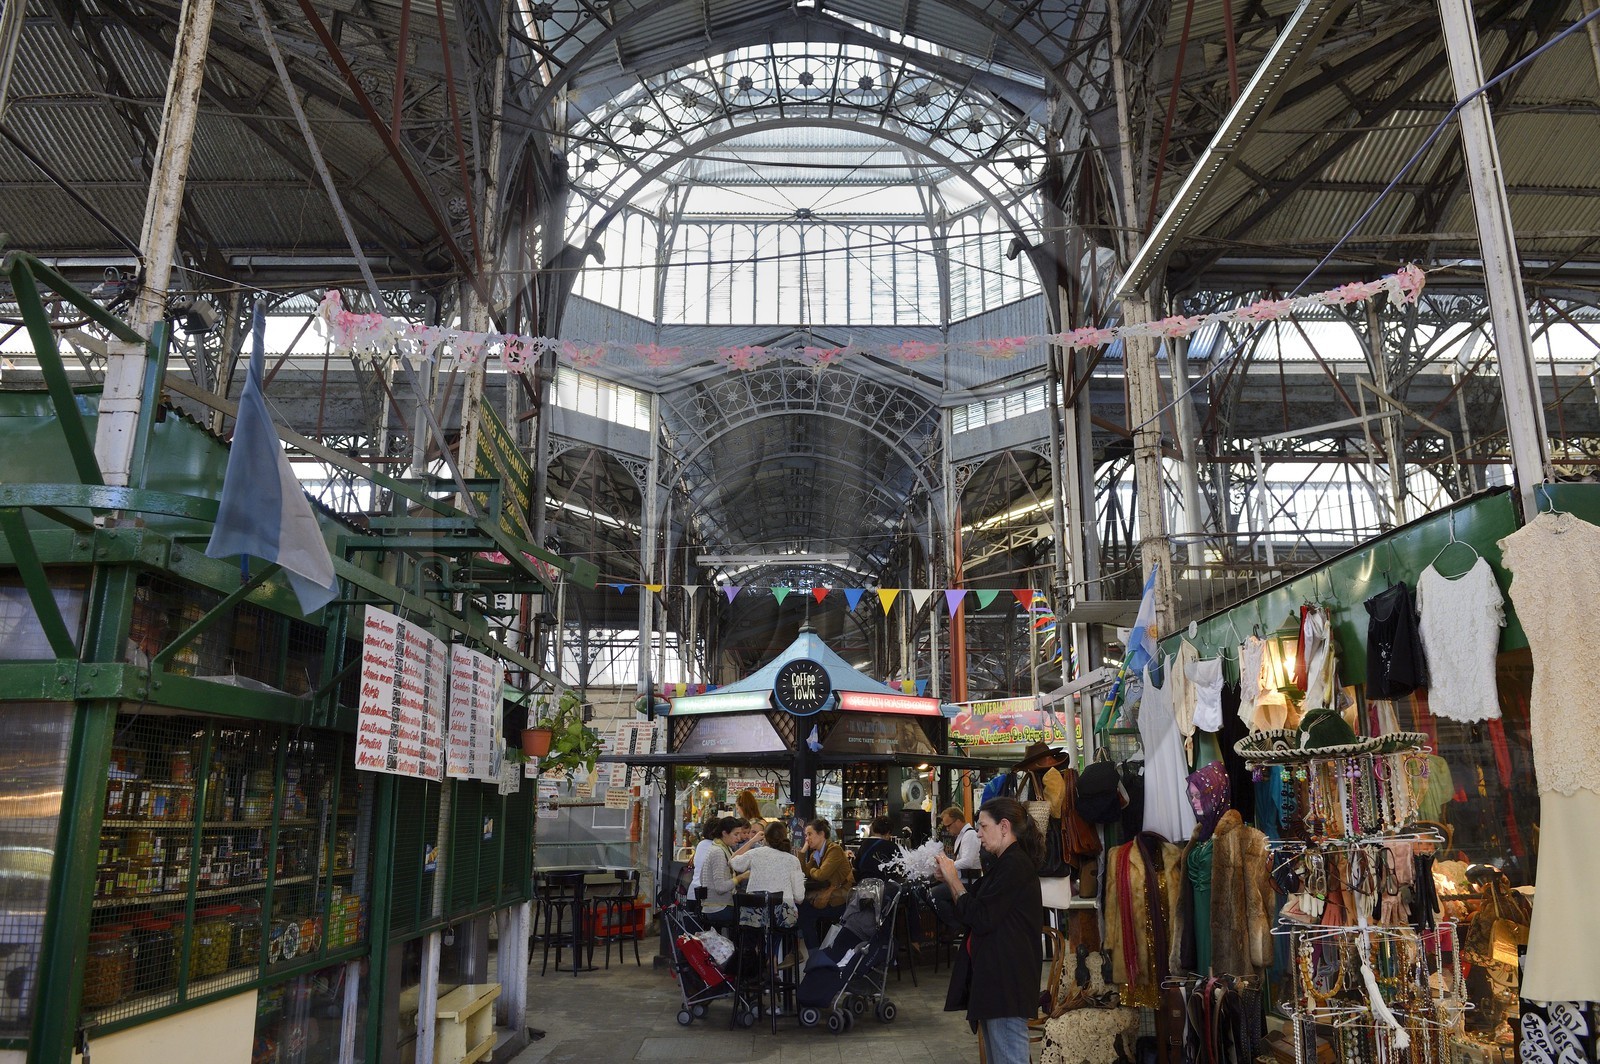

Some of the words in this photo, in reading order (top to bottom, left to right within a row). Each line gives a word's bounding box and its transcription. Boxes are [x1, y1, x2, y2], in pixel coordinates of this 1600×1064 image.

[497, 433, 529, 487] ARTESANALES
[850, 696, 884, 708] SPECIALTY
[884, 698, 910, 710] ROASTED
[910, 700, 933, 711] COFFEE
[973, 701, 1003, 716] FRUTERIA
[980, 728, 1011, 743] Verduras
